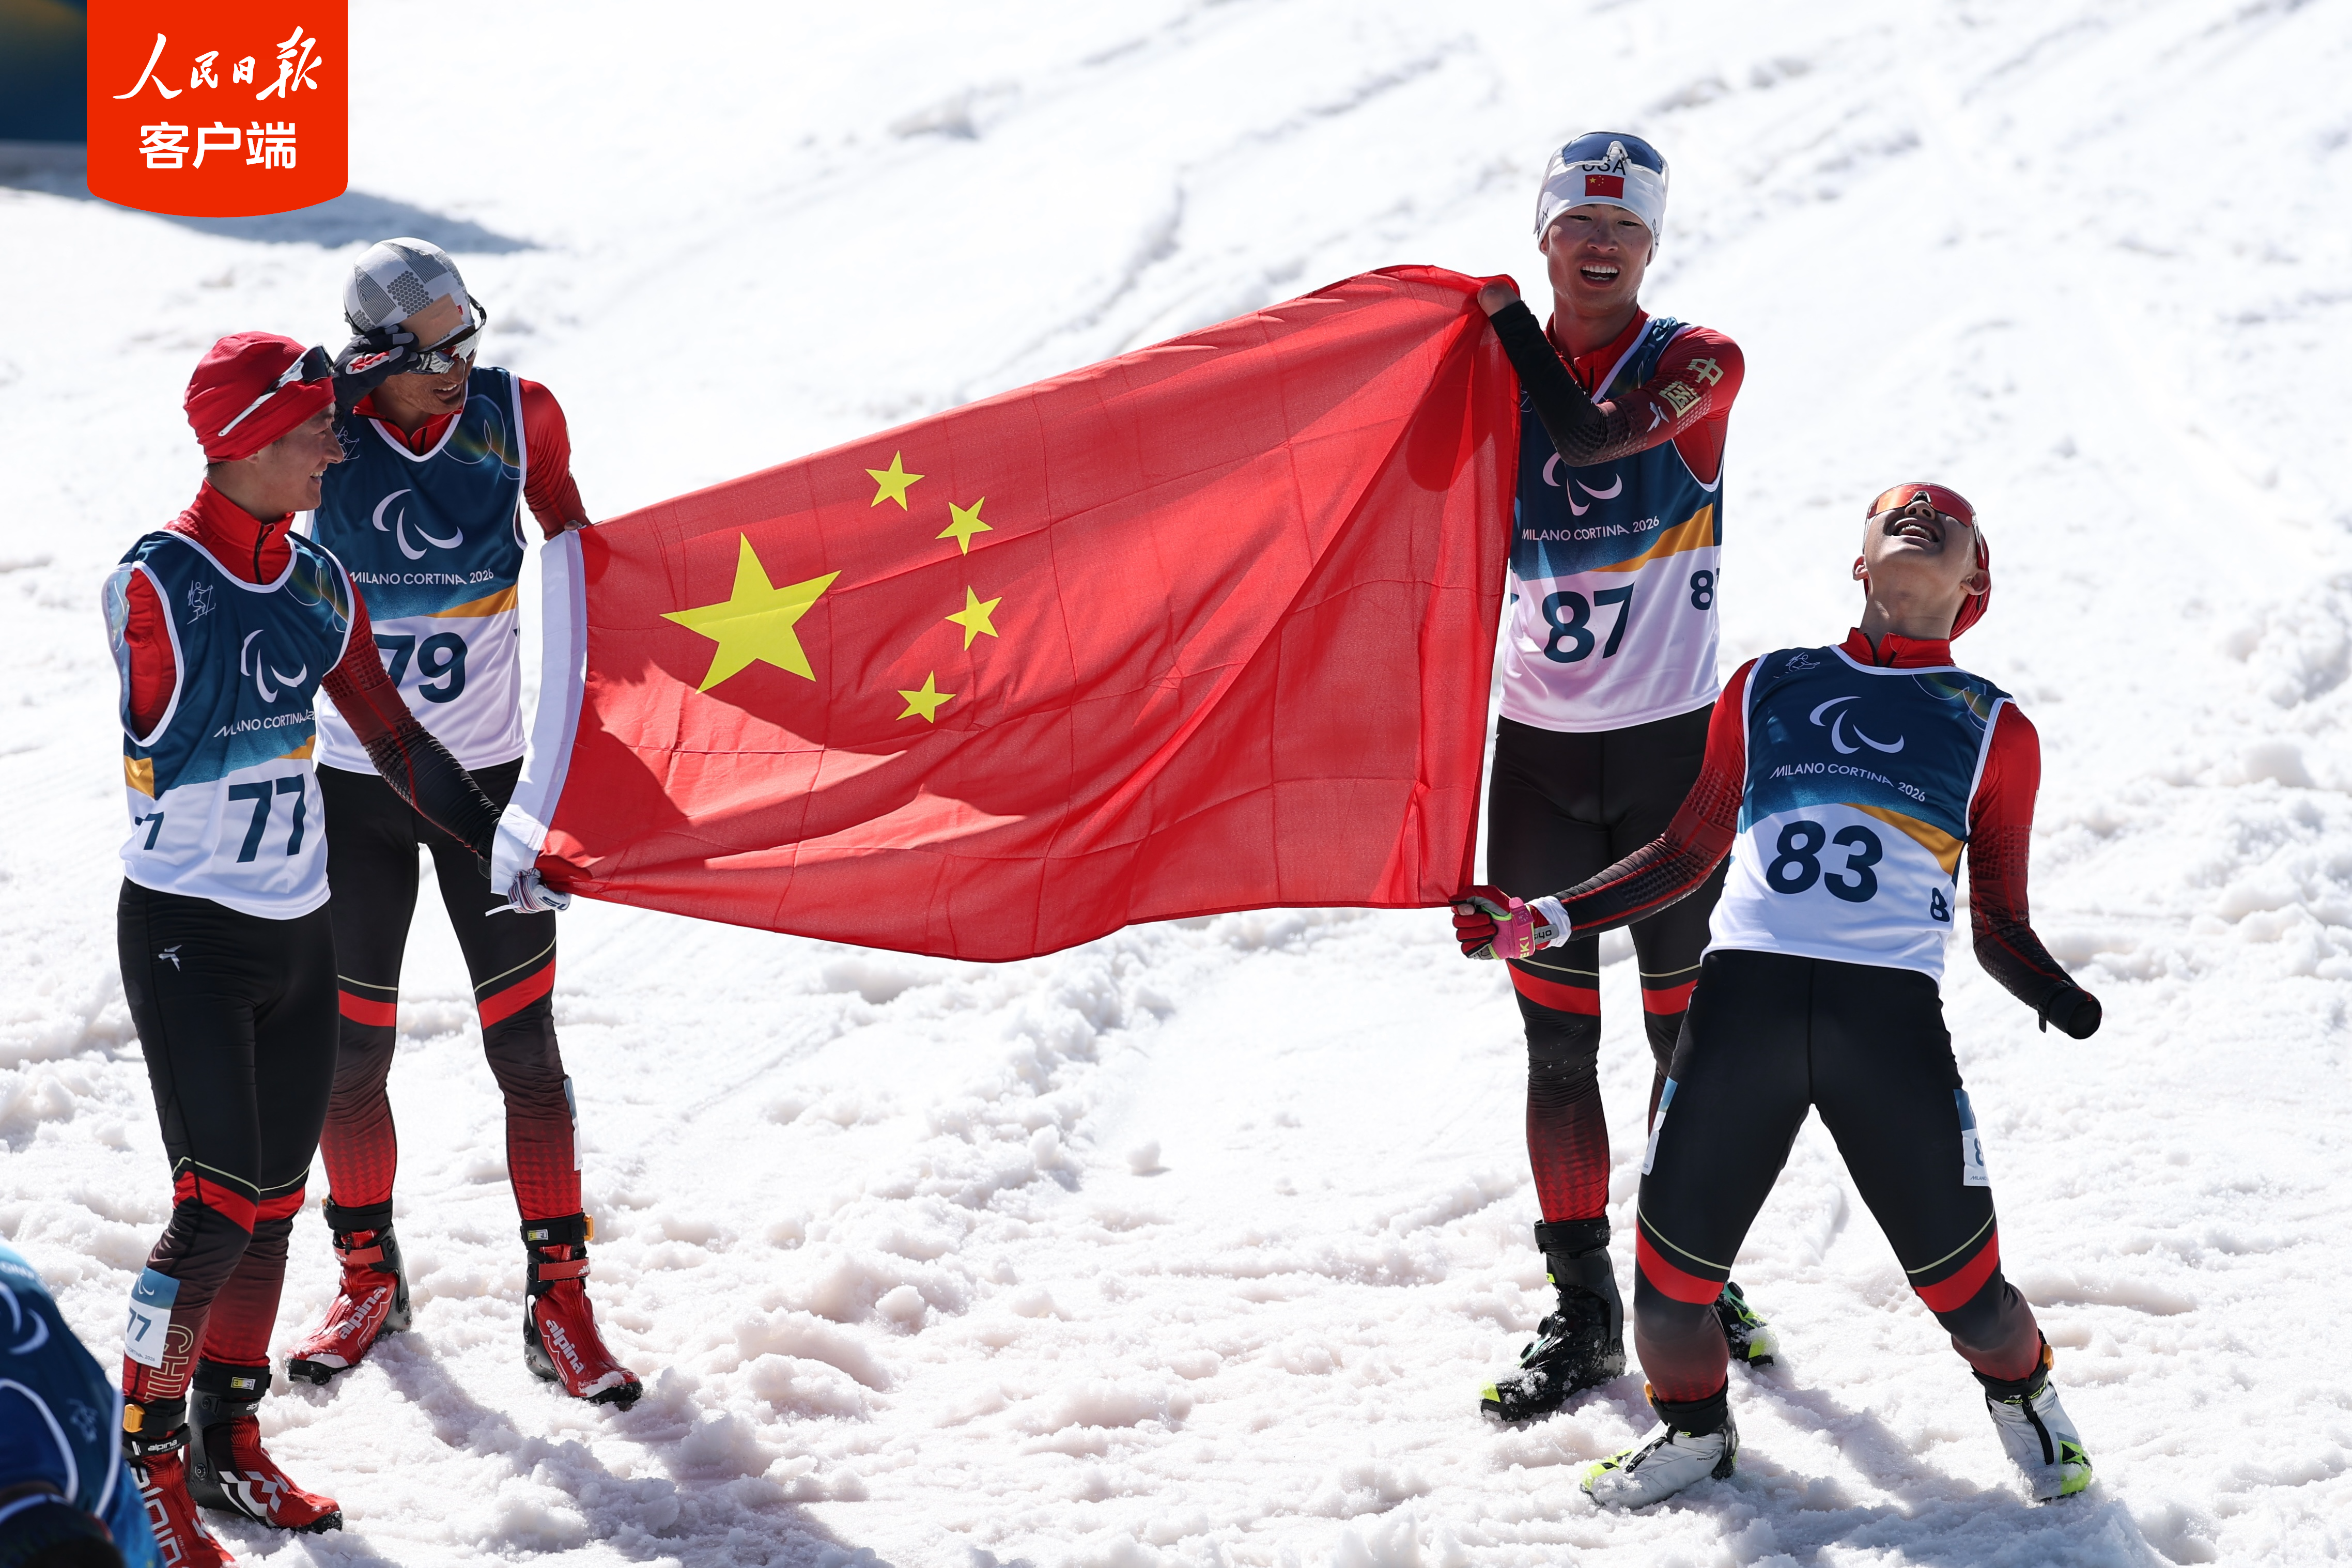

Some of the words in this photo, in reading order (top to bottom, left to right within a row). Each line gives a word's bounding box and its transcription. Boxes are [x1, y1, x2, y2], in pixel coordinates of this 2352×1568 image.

[1522, 529, 1571, 541] MILANO
[1574, 524, 1630, 540] CORTINA
[1633, 516, 1660, 533] 2026
[350, 572, 400, 584] MILANO
[404, 573, 467, 585] CORTINA
[470, 568, 493, 583] 2026
[1542, 582, 1635, 663] 87
[377, 632, 468, 703] 79
[264, 709, 308, 728] CORTINA
[1769, 763, 1824, 779] MILANO
[1828, 764, 1894, 787] CORTINA
[1897, 782, 1925, 802] 2026
[228, 774, 305, 863] 77
[1766, 820, 1882, 903] 83
[339, 1286, 387, 1340] alpina
[546, 1319, 584, 1375] alpina
[148, 1439, 177, 1451] alpina
